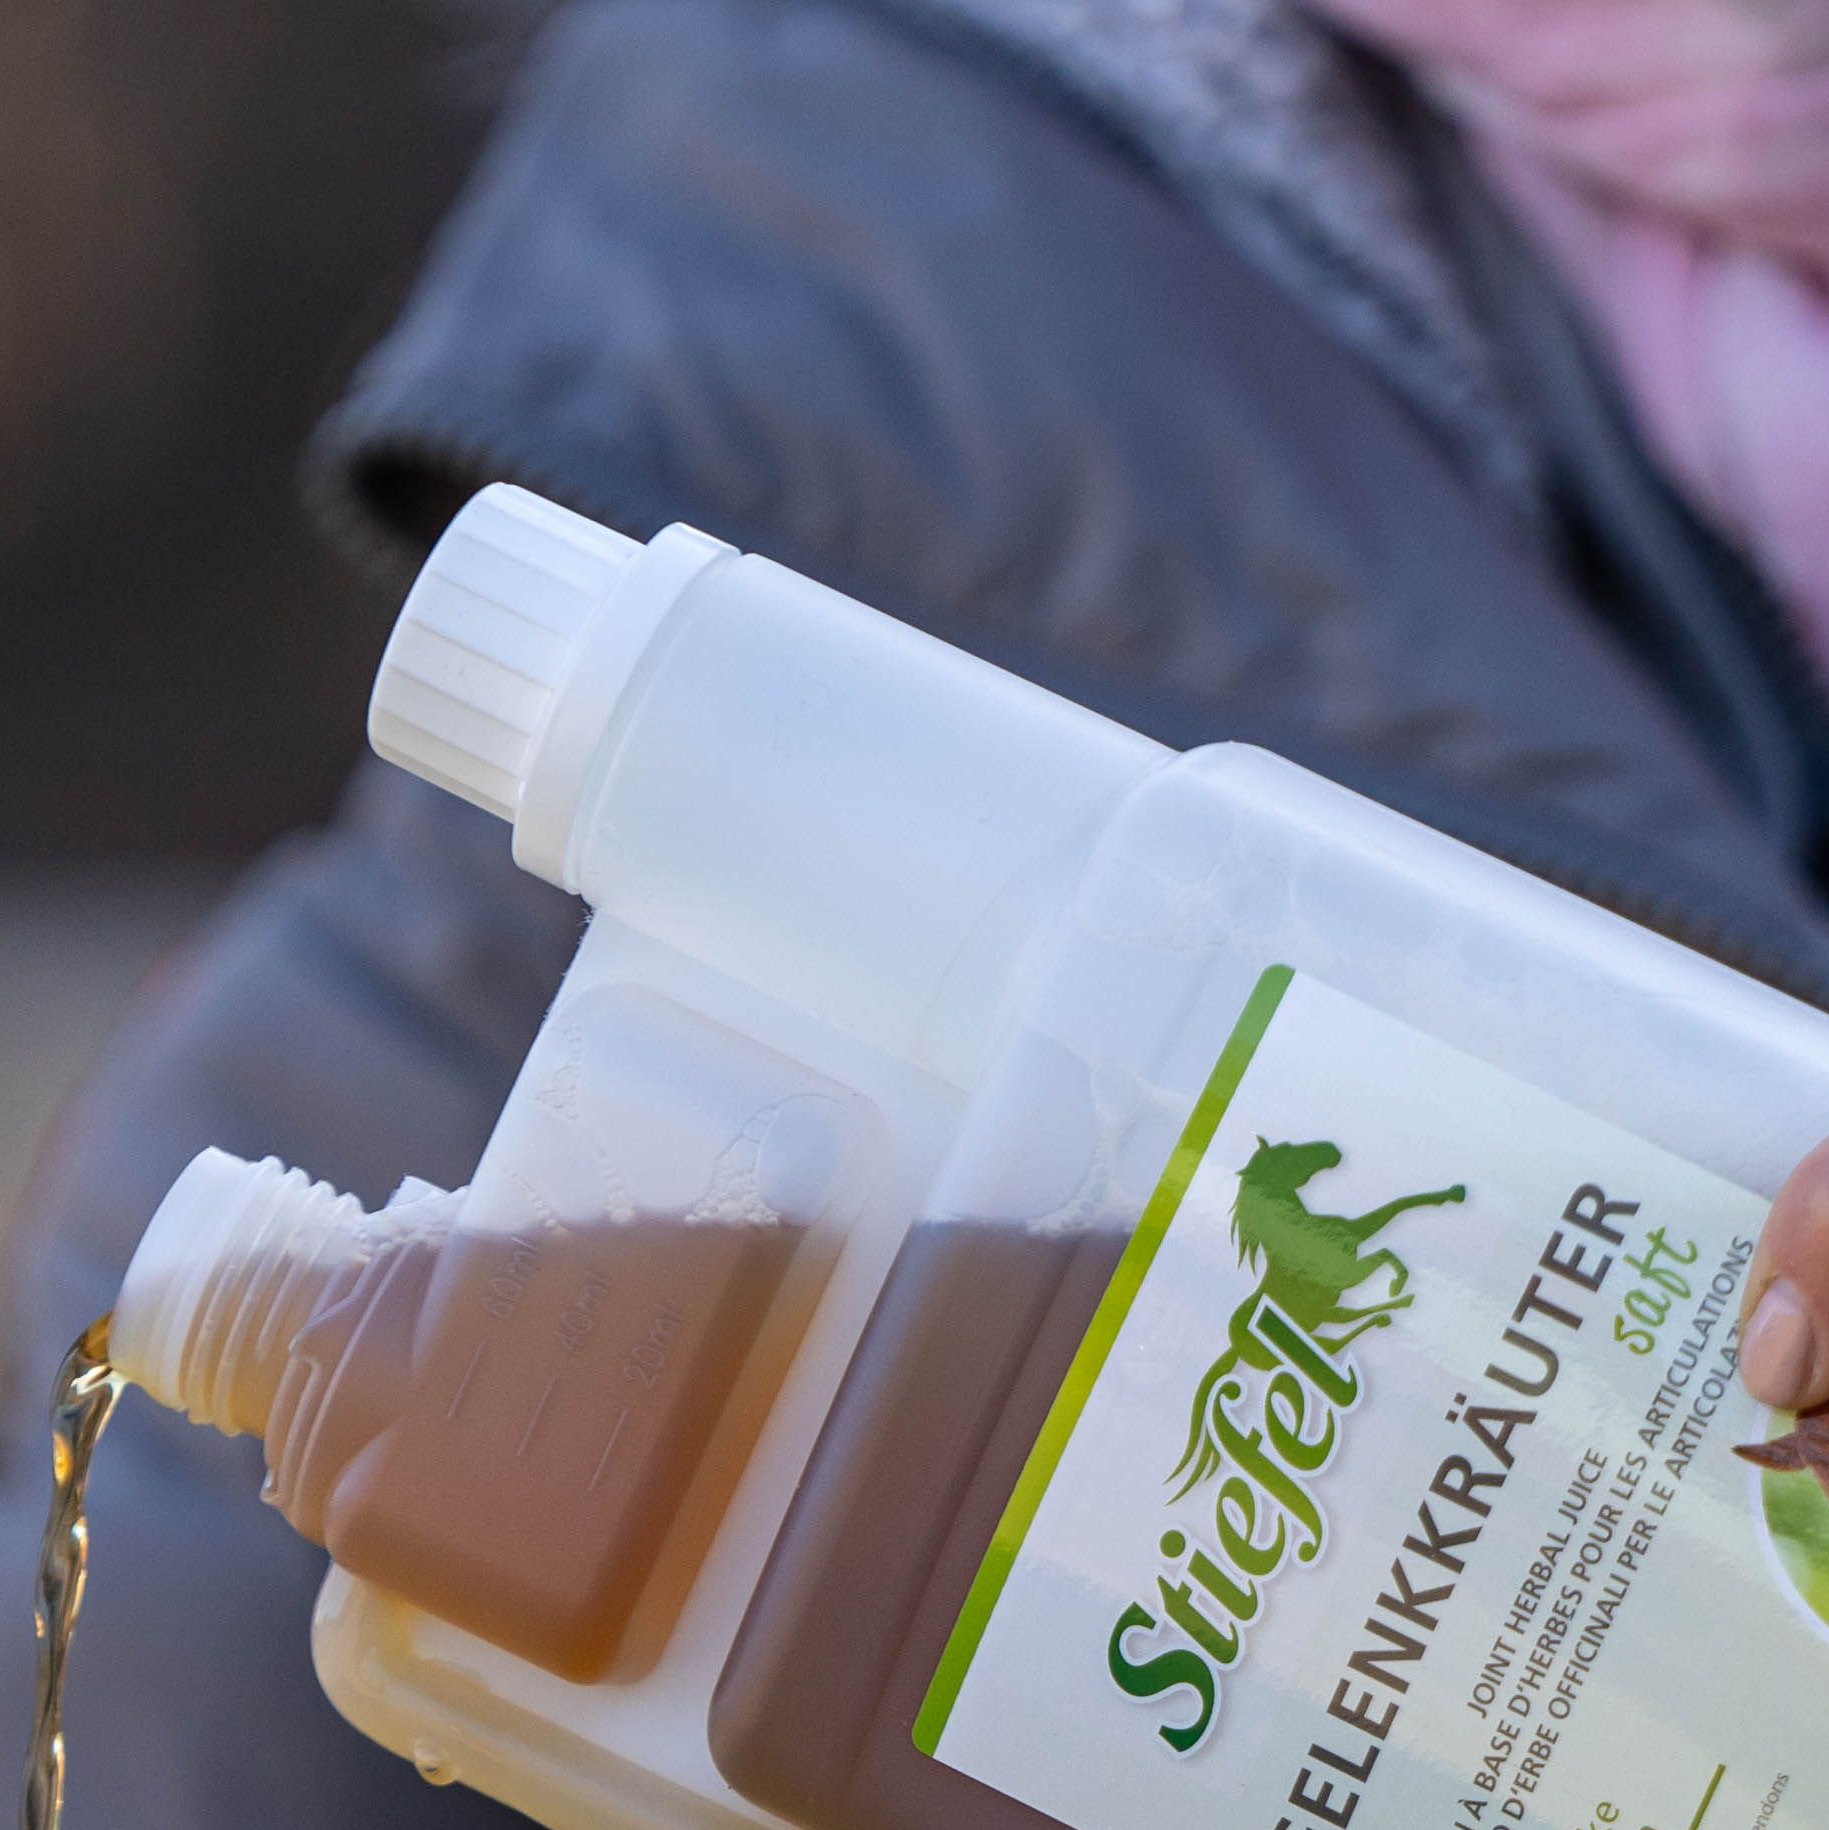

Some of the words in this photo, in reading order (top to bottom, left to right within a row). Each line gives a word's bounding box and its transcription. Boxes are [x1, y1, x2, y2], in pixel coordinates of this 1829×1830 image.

[1613, 1227, 1698, 1356] saft
[1107, 1303, 1358, 1753] Stiefel
[1454, 1797, 1489, 1822] À
[1473, 1720, 1521, 1793] BASE
[1570, 1504, 1623, 1582] POUR
[1609, 1452, 1647, 1501] LES
[1638, 1236, 1754, 1450] ARTICULATIONS
[1467, 1636, 1516, 1719] JOINT
[1504, 1532, 1571, 1635] HERBAL
[1558, 1448, 1608, 1526] JUICE
[1548, 1573, 1631, 1720] OFFICINALI
[1616, 1519, 1658, 1571] PER
[1643, 1481, 1675, 1516] LE
[1665, 1318, 1741, 1480] ARTICOLA
